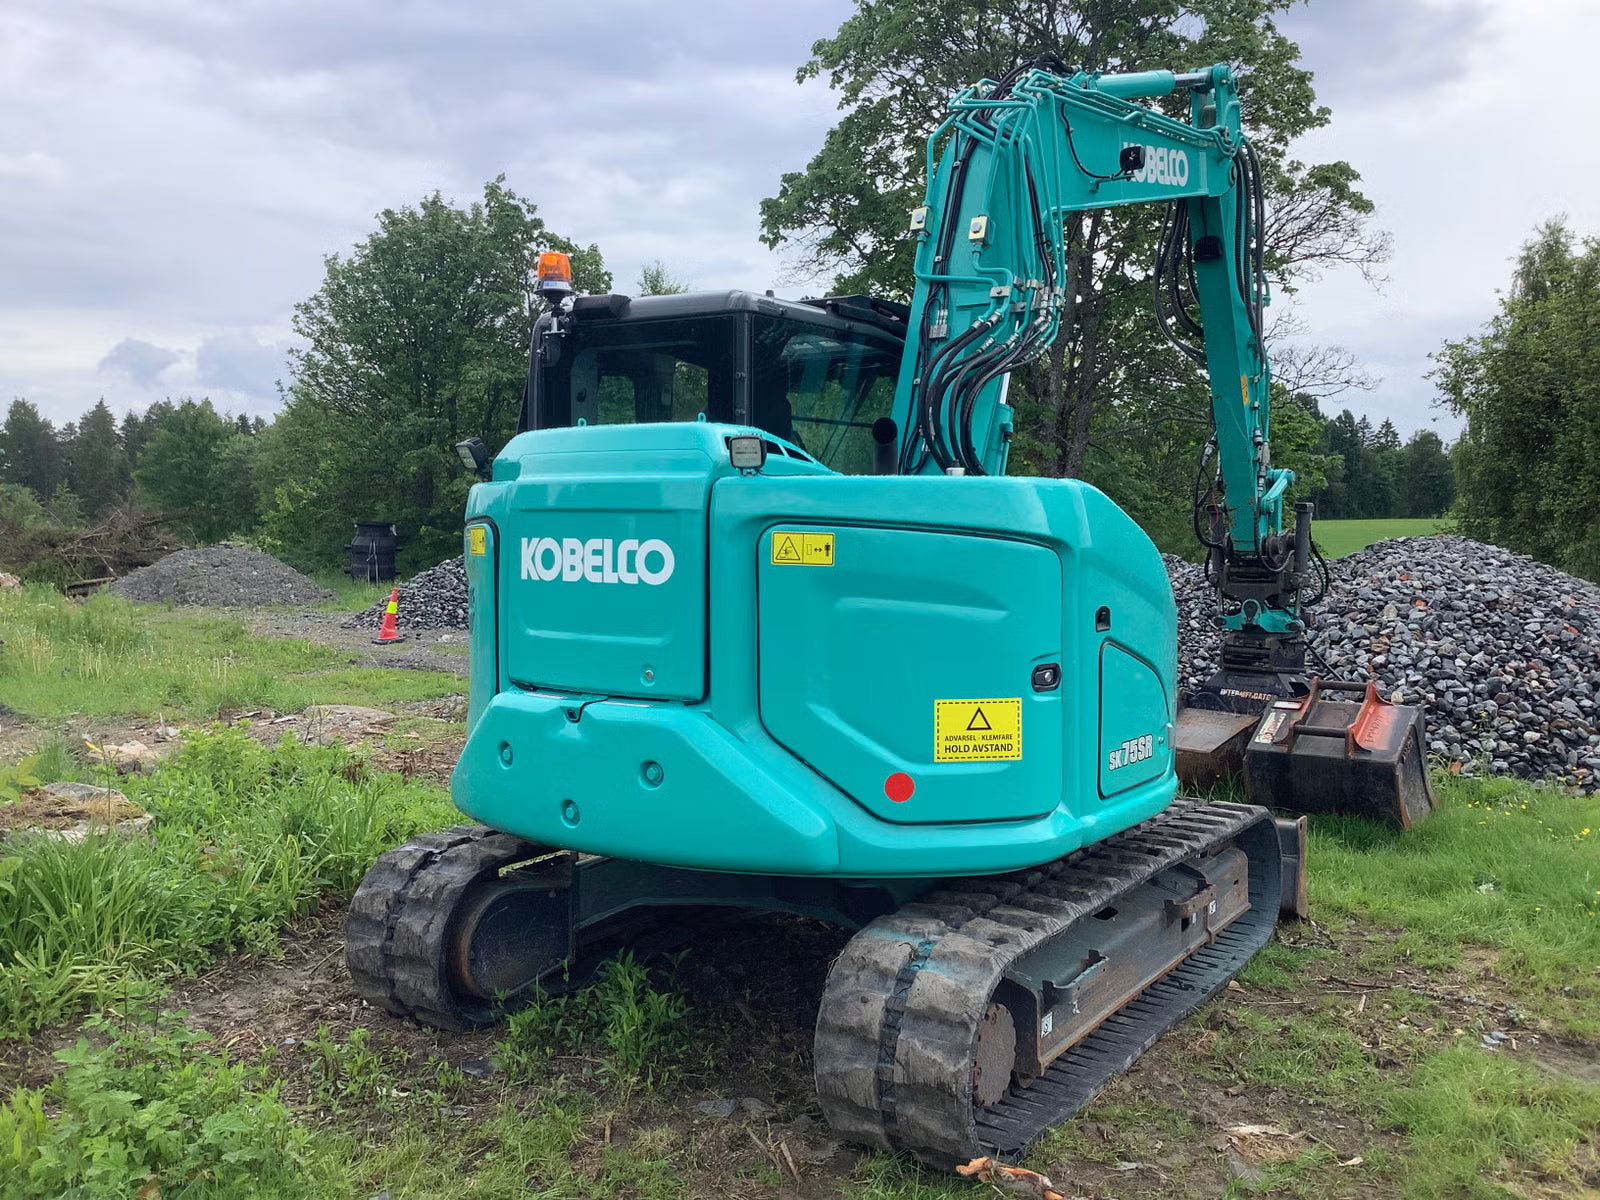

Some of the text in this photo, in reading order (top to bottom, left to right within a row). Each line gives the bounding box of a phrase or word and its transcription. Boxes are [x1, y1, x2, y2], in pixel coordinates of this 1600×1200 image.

[1123, 142, 1189, 187] OBELCO
[520, 537, 675, 586] KOBELCO
[944, 734, 977, 742] ADVARSEL
[981, 733, 1013, 741] KLEMFARE
[944, 743, 1014, 753] HOLD AVSTAND
